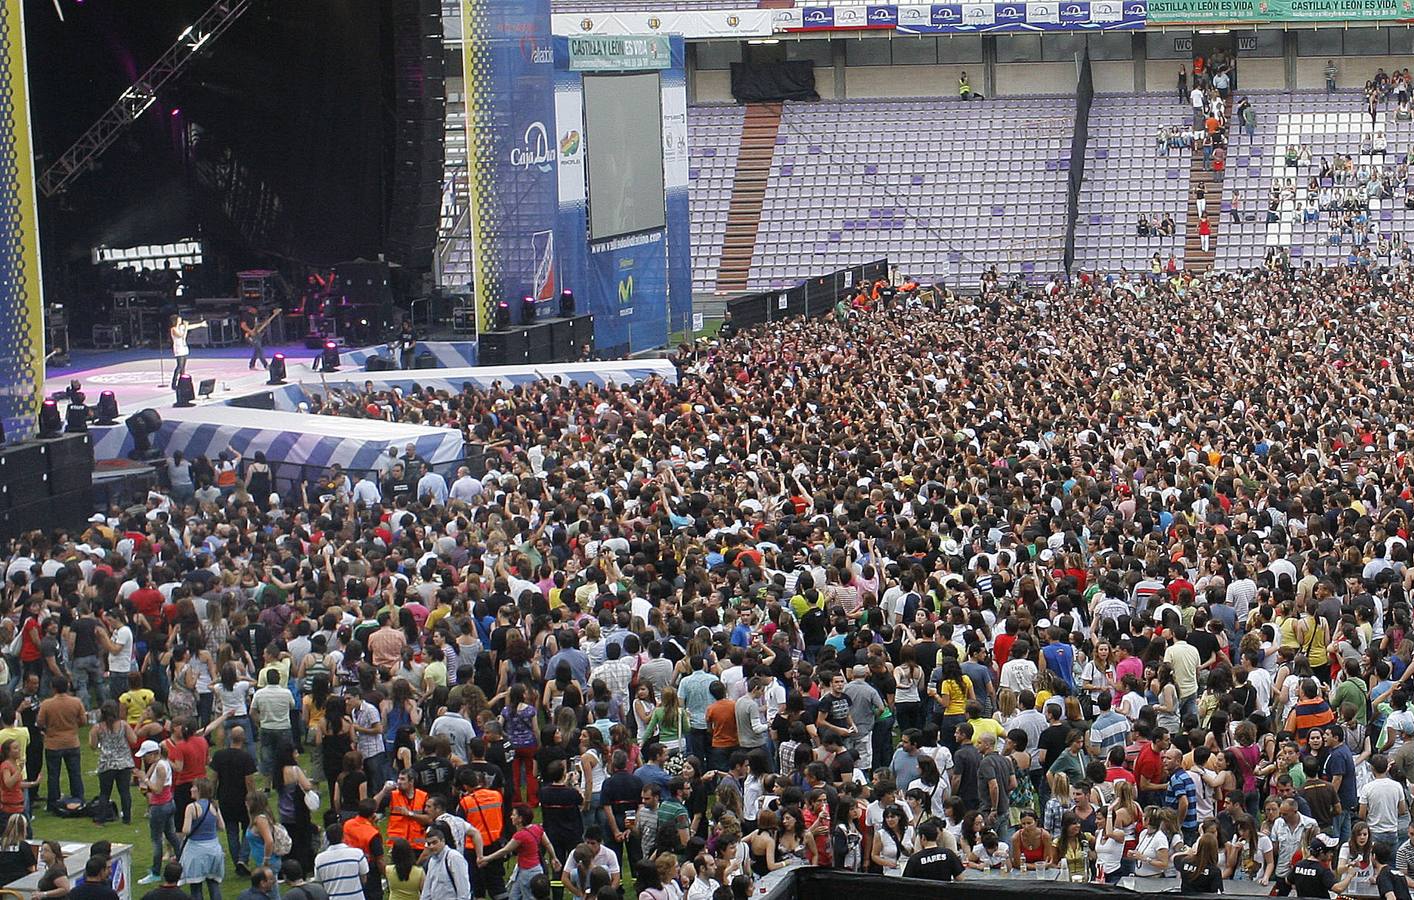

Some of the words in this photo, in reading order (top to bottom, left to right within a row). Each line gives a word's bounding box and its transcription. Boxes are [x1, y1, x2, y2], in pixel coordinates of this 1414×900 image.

[1149, 1, 1188, 12] CASTILLA
[1188, 1, 1195, 11] Y
[1198, 0, 1220, 10] LEÓN
[1221, 1, 1232, 10] ES
[1233, 0, 1254, 10] VIDA
[1291, 1, 1330, 11] CASTILLA
[1330, 1, 1336, 10] Y
[1365, 0, 1375, 9] ES
[1377, 0, 1397, 9] VIDA
[572, 39, 603, 56] CASTILLA
[624, 40, 633, 56] ES
[1176, 39, 1192, 49] WC
[1240, 38, 1255, 49] WC
[920, 853, 947, 865] BARES
